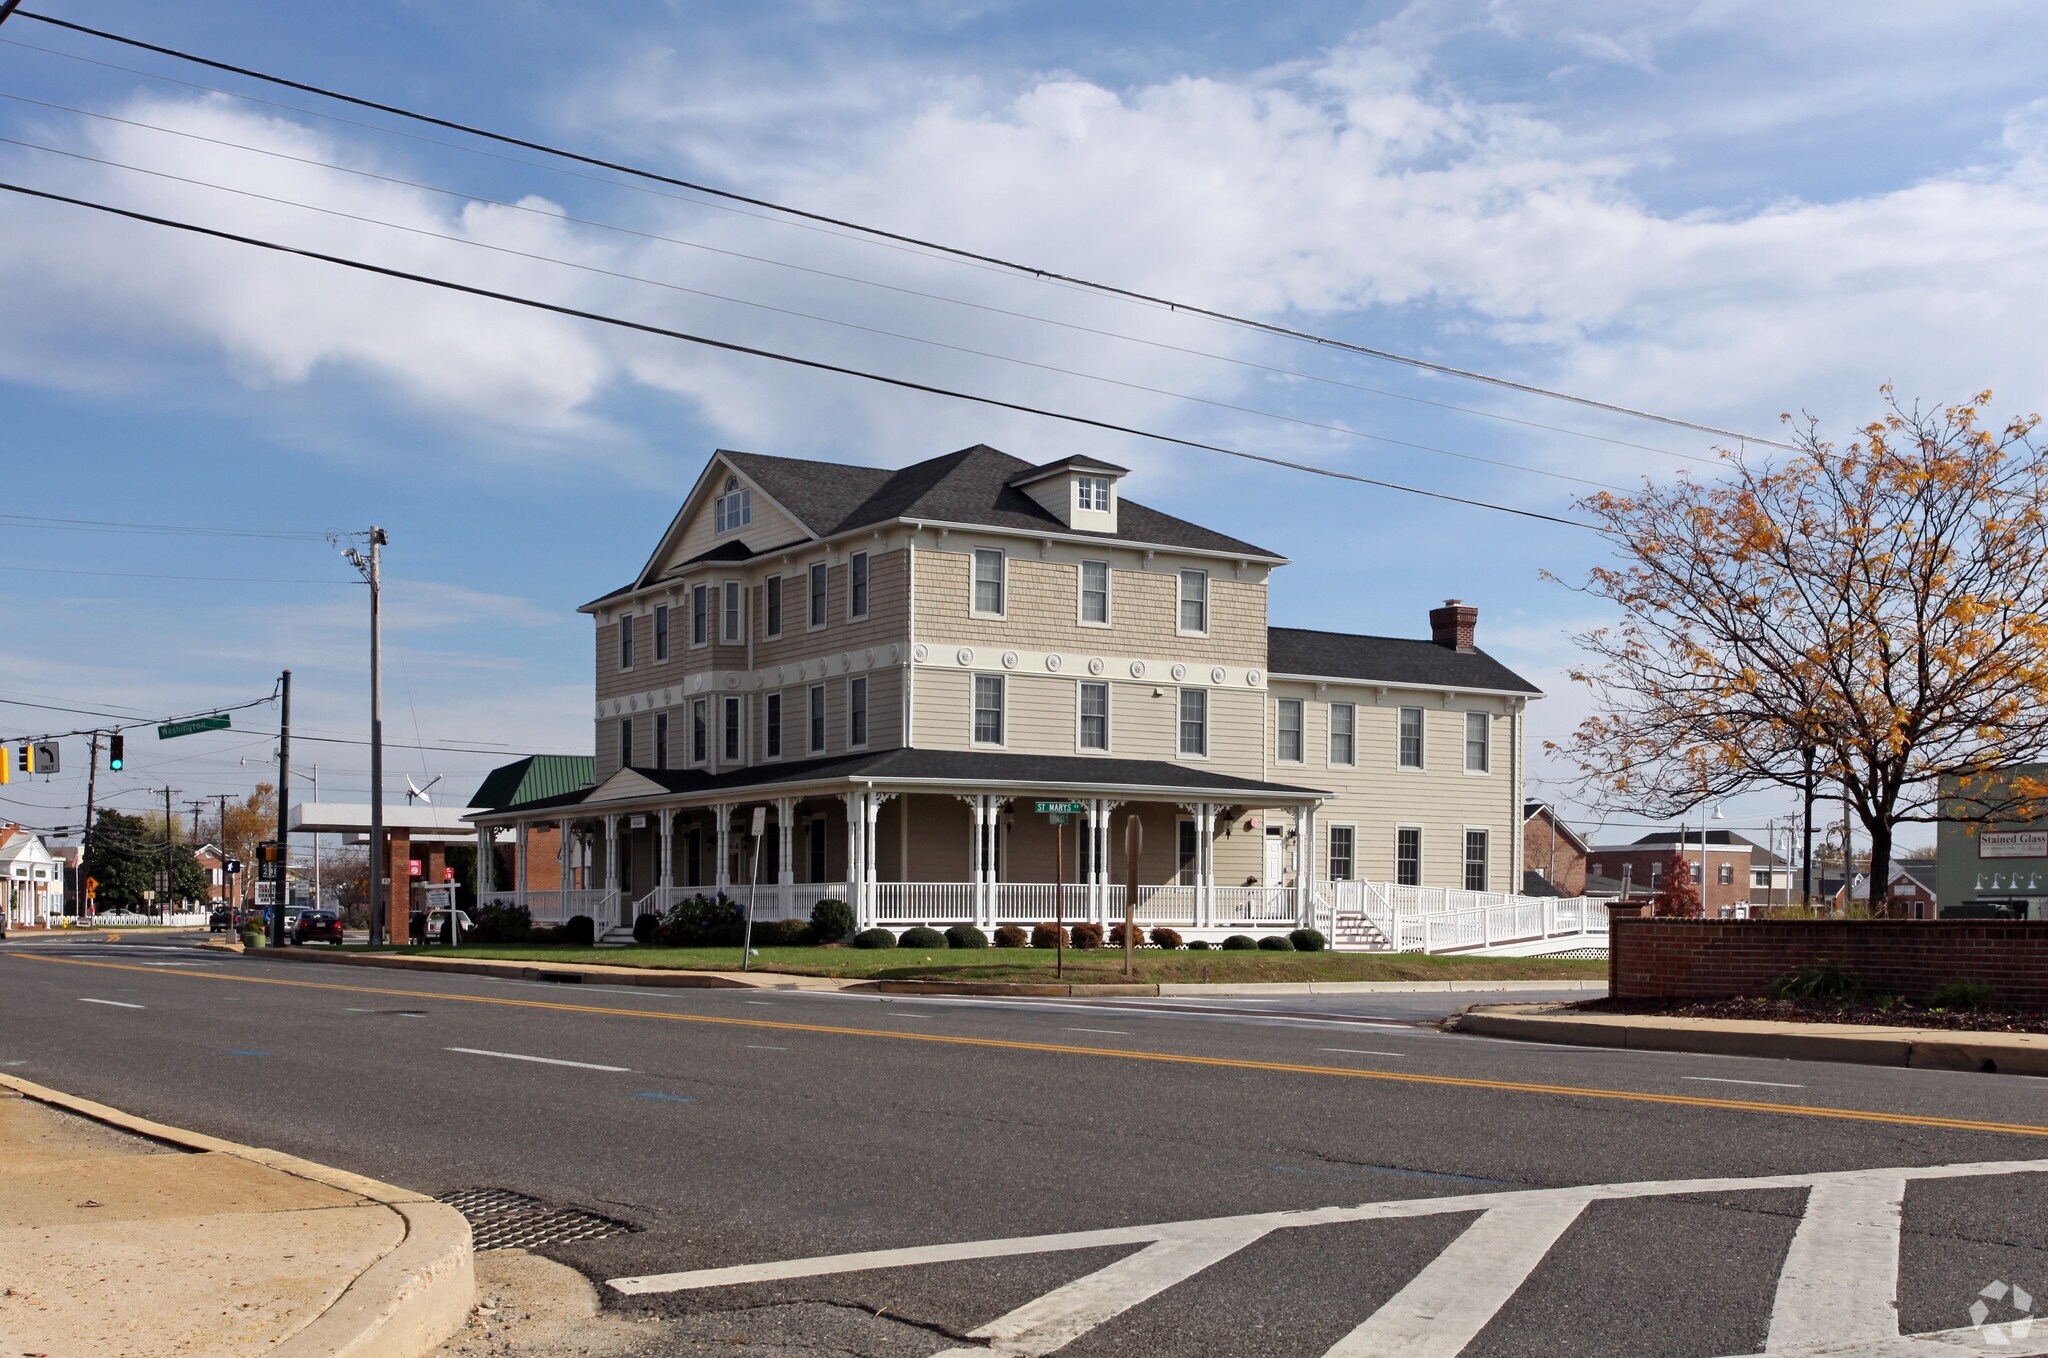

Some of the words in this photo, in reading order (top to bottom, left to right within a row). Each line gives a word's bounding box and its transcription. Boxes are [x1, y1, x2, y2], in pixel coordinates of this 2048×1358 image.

[161, 722, 206, 736] Washington
[1038, 803, 1045, 812] ST
[1049, 803, 1071, 812] MARYS
[1981, 834, 2017, 844] Stained
[2020, 834, 2046, 843] Glass
